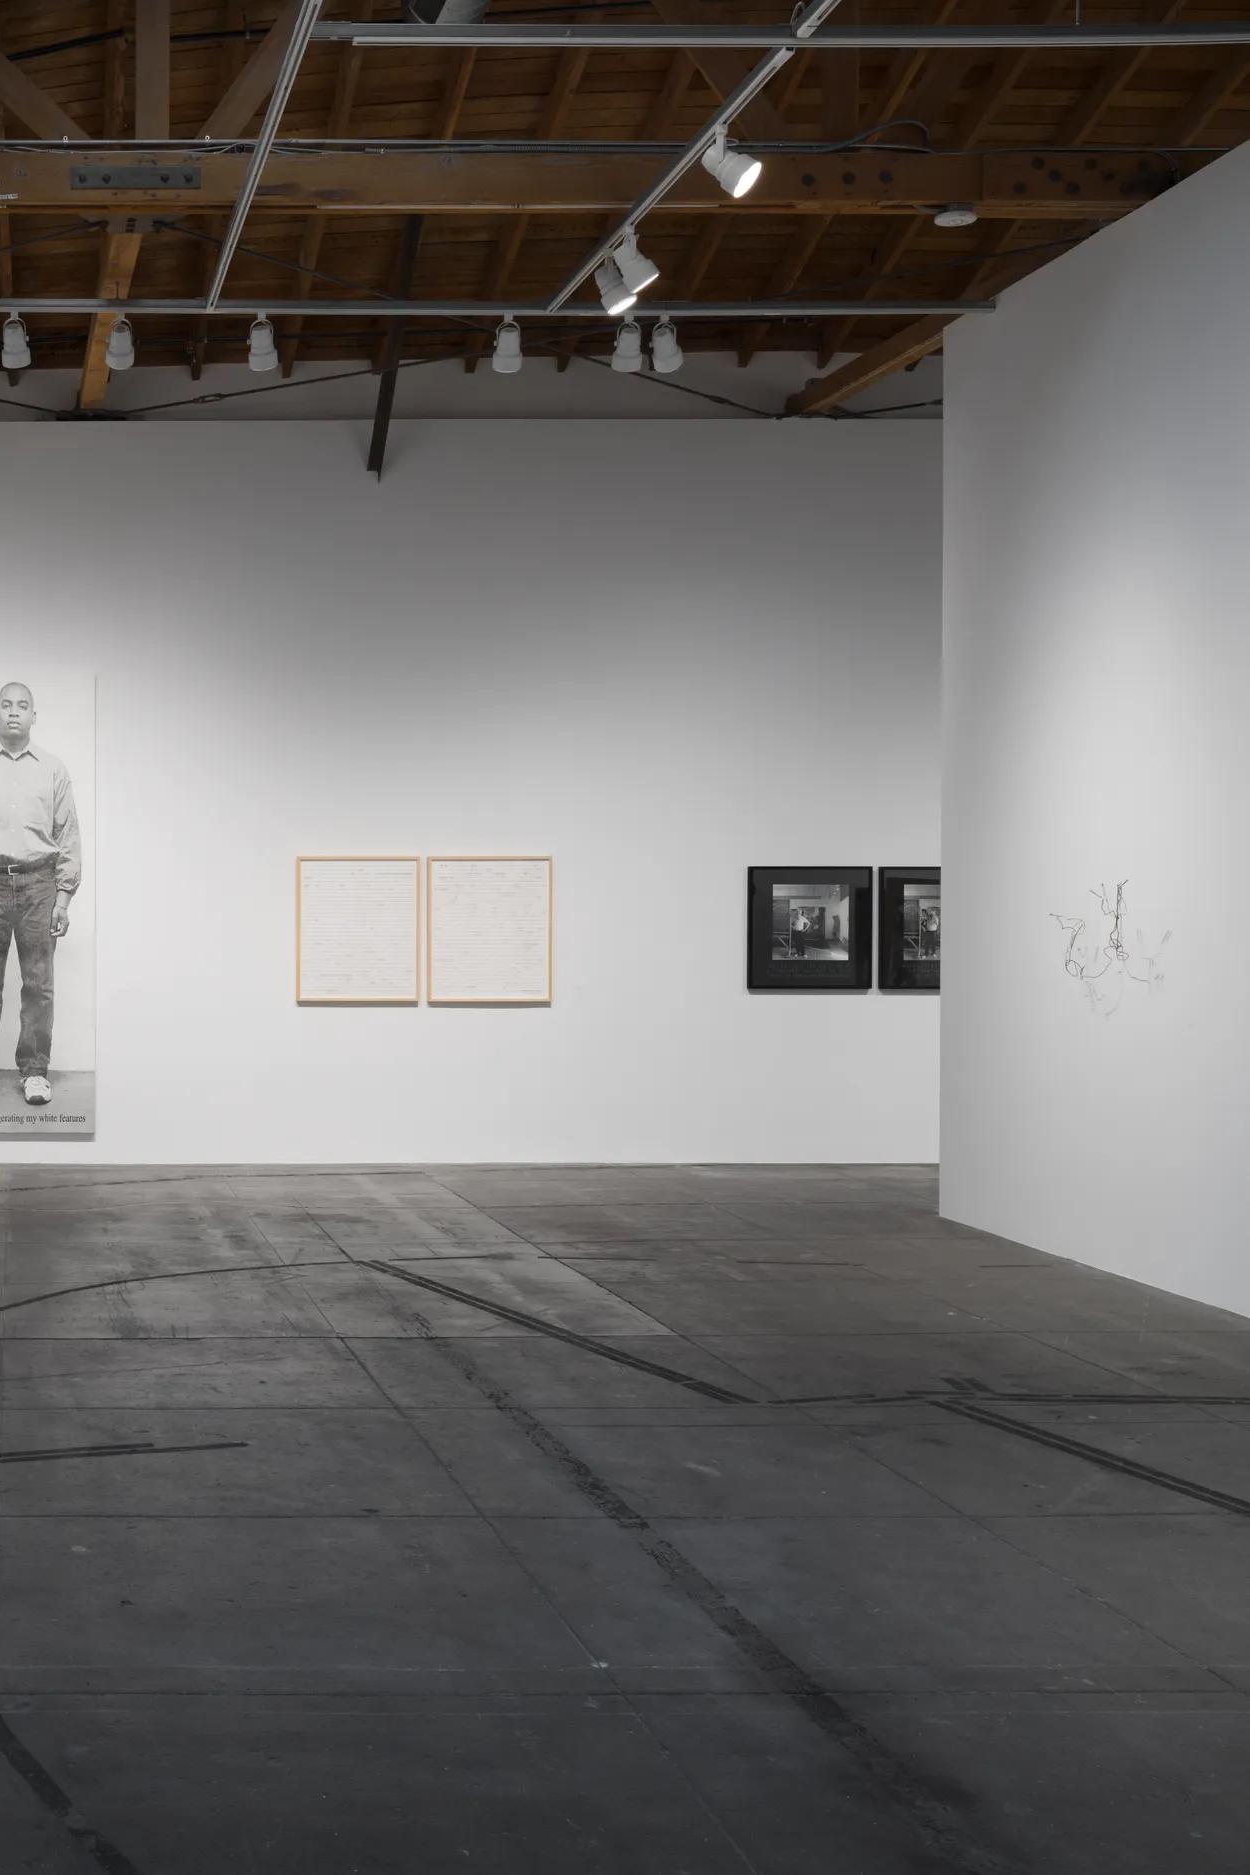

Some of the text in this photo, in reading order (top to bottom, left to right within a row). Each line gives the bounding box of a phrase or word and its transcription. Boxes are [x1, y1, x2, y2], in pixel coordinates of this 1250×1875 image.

[26, 1115, 36, 1123] my
[39, 1113, 57, 1123] white
[59, 1114, 86, 1123] features
